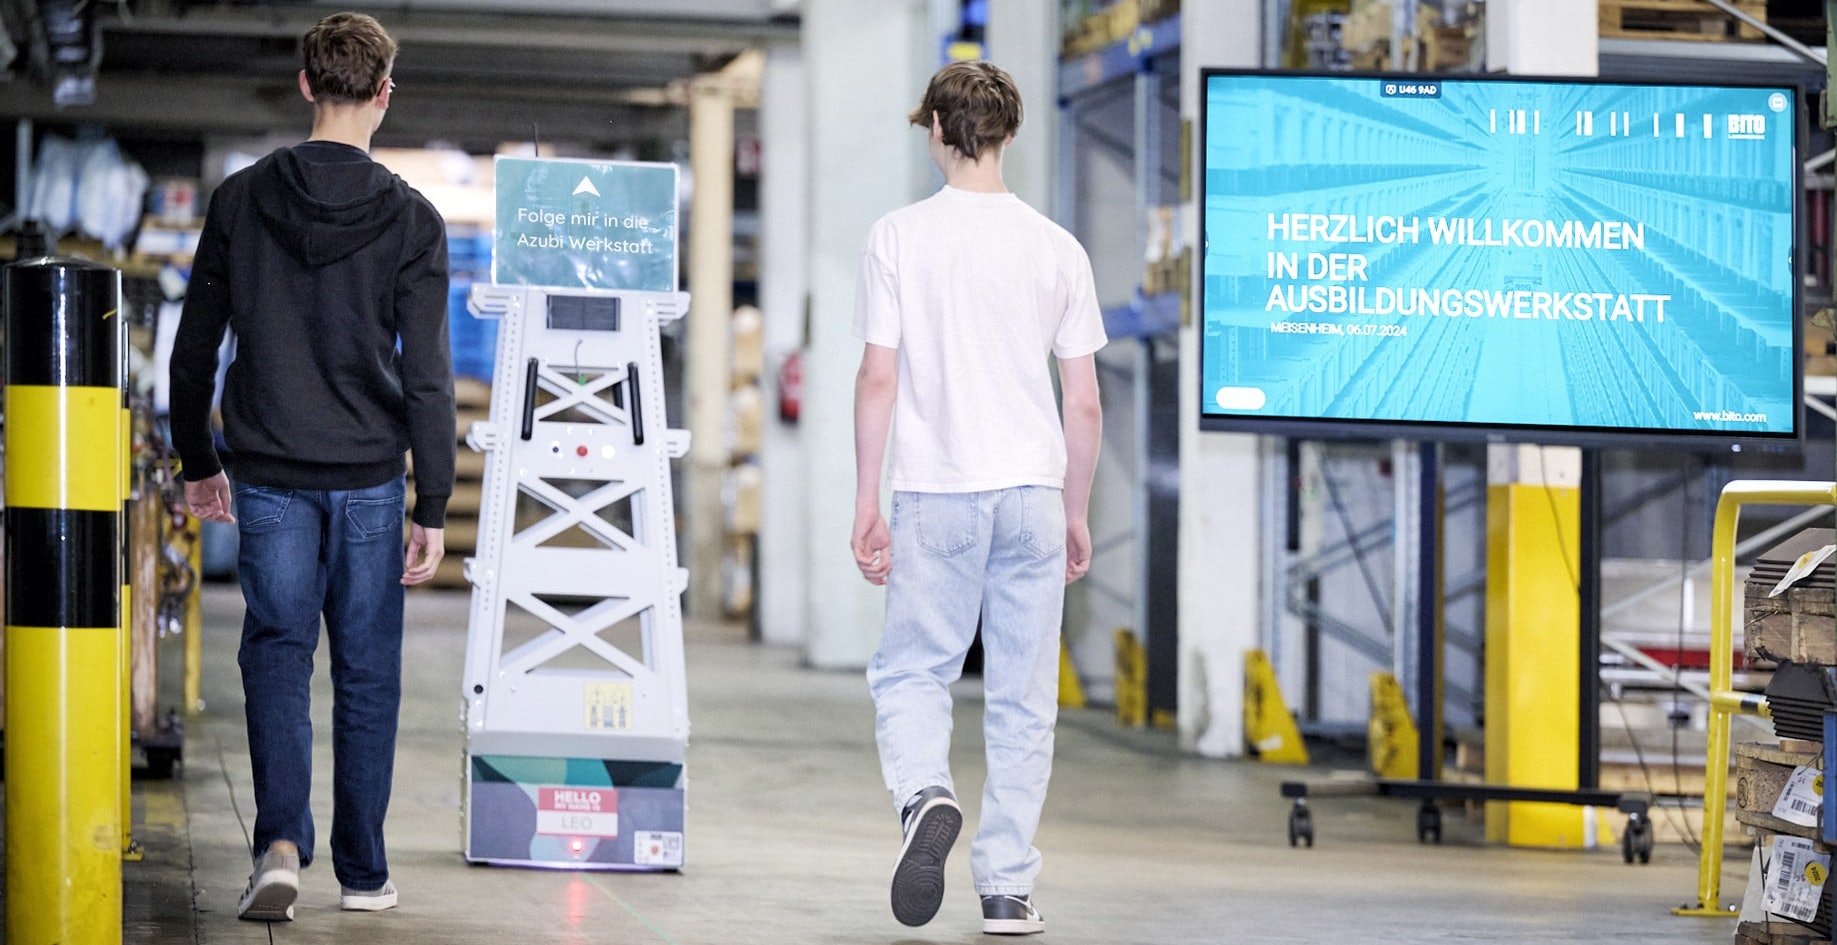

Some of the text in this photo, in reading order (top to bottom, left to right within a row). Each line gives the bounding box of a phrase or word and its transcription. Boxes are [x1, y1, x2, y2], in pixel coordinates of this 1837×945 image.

[1727, 113, 1766, 134] BITO
[517, 208, 649, 230] Folge mir in die
[1267, 213, 1645, 250] HERZLICH WILLKOMMEN
[517, 233, 653, 255] Azubi Werkstatt
[1267, 251, 1369, 281] IN DER
[1265, 284, 1671, 323] AUSBILDUNGSWERKSTATT
[1270, 321, 1407, 337] MEISENHEIM, 06.07.2024
[1693, 410, 1767, 423] www.bito.com
[554, 790, 601, 804] HELLO
[561, 816, 592, 830] LEO
